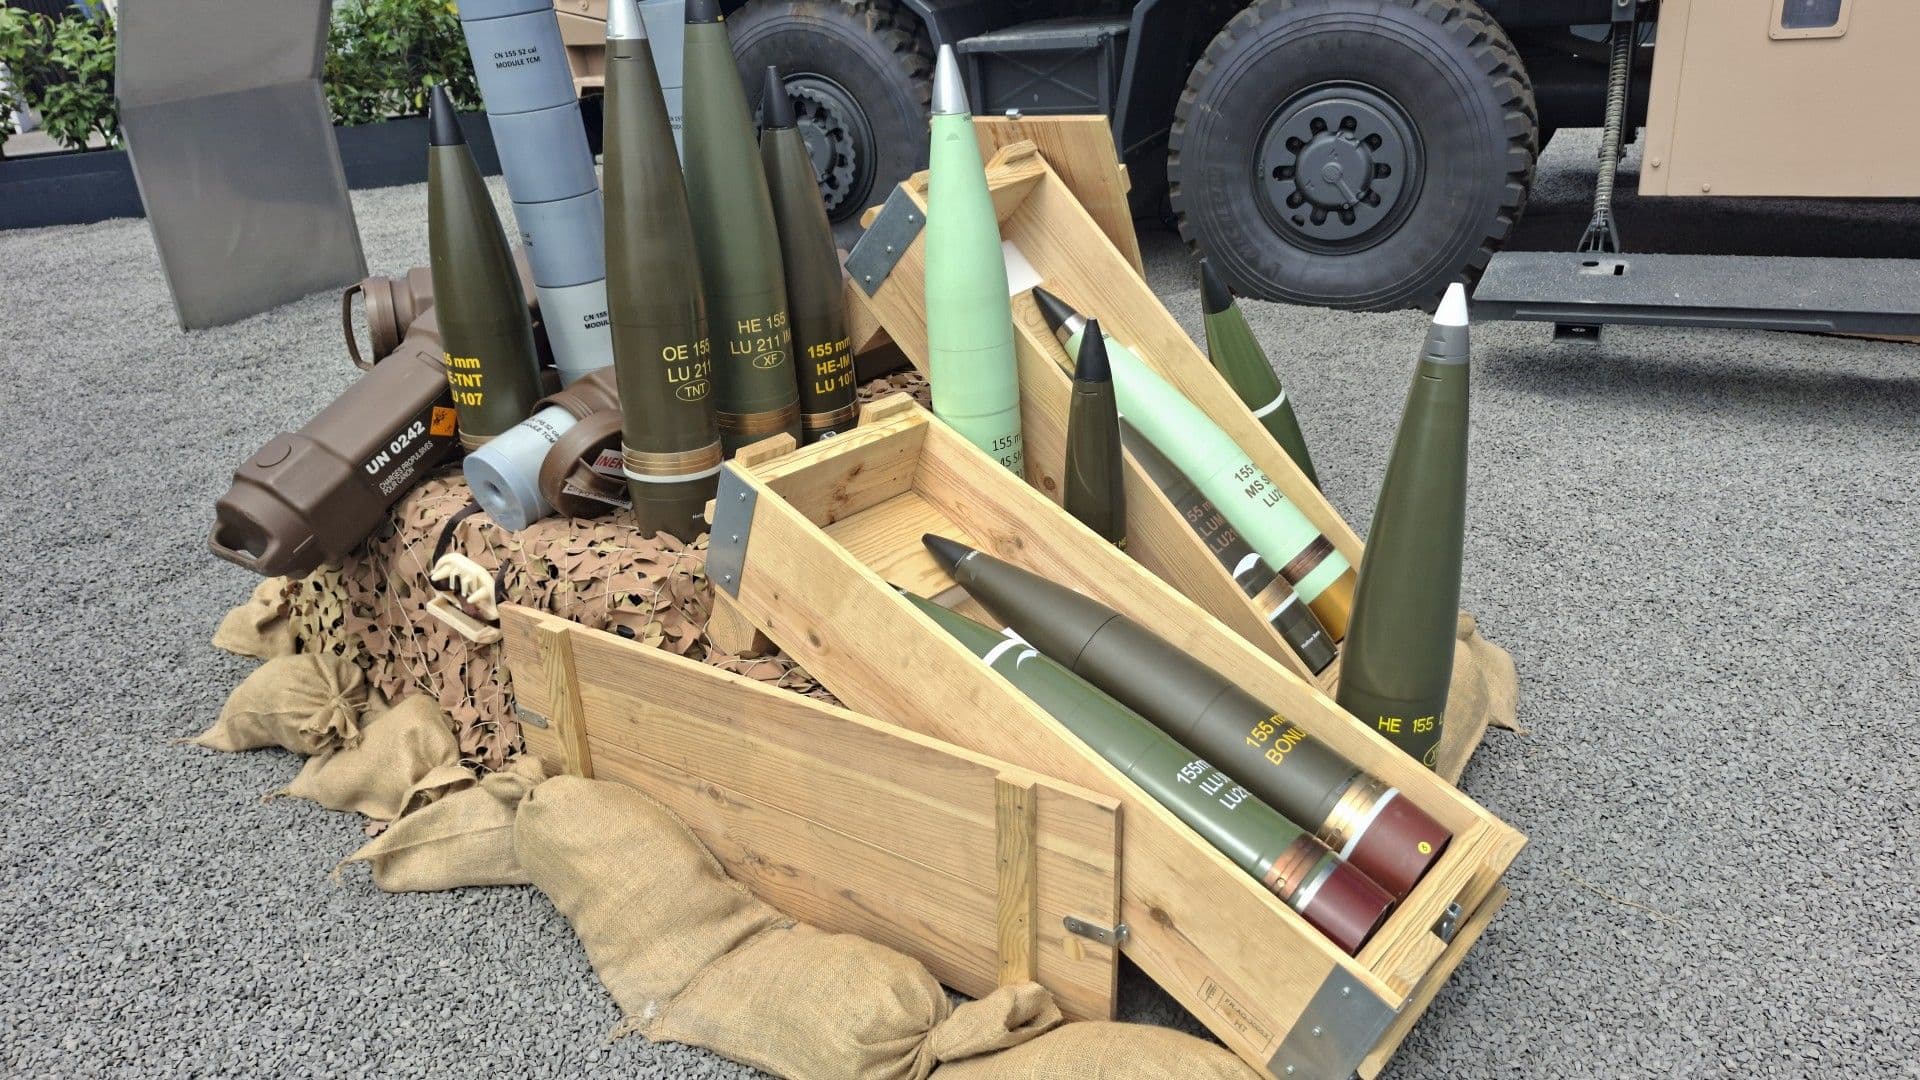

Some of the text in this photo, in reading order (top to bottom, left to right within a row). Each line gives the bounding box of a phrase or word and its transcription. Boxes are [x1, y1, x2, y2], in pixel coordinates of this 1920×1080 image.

[496, 56, 541, 68] MODULE TCM
[596, 311, 607, 319] 155
[738, 311, 785, 334] HE 155
[662, 338, 709, 361] OE 155
[730, 340, 751, 354] LU
[756, 334, 779, 352] 211
[808, 342, 832, 359] 155
[453, 357, 481, 368] mm
[763, 353, 777, 366] XF
[668, 359, 711, 382] LU 211
[684, 382, 706, 397] TNT
[815, 370, 853, 394] LU 107
[460, 392, 483, 405] 107
[365, 420, 426, 475] UN 0242
[992, 435, 1012, 452] 155
[1234, 464, 1255, 482] 155
[1245, 479, 1265, 499] MS
[1378, 715, 1403, 733] HE
[1412, 716, 1435, 733] 155
[1246, 720, 1275, 748] 155
